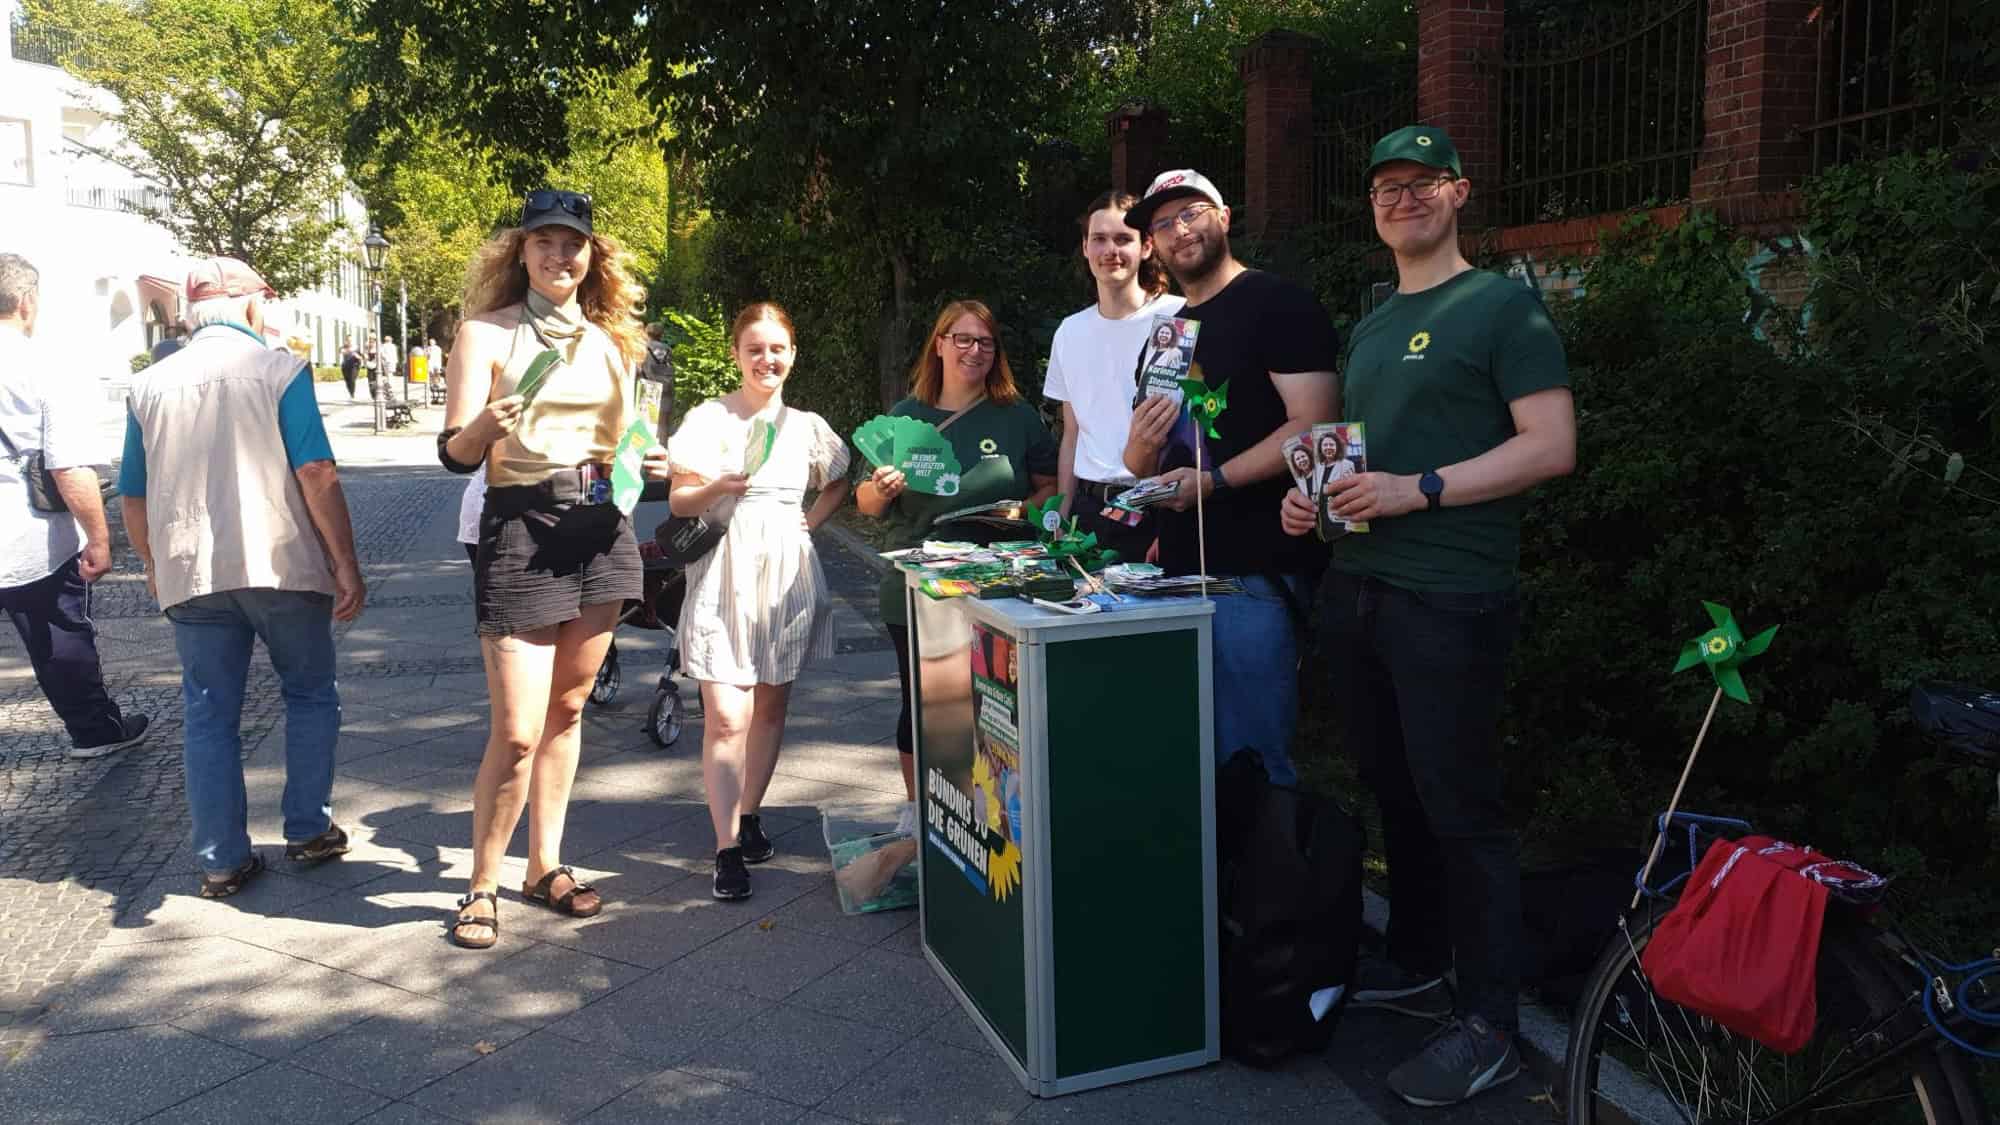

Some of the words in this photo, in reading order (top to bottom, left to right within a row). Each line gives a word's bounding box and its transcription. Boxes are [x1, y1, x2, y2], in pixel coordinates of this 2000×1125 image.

[929, 767, 971, 825] BÜNDNIS
[928, 799, 944, 834] DIE
[946, 816, 988, 876] GRÜNEN
